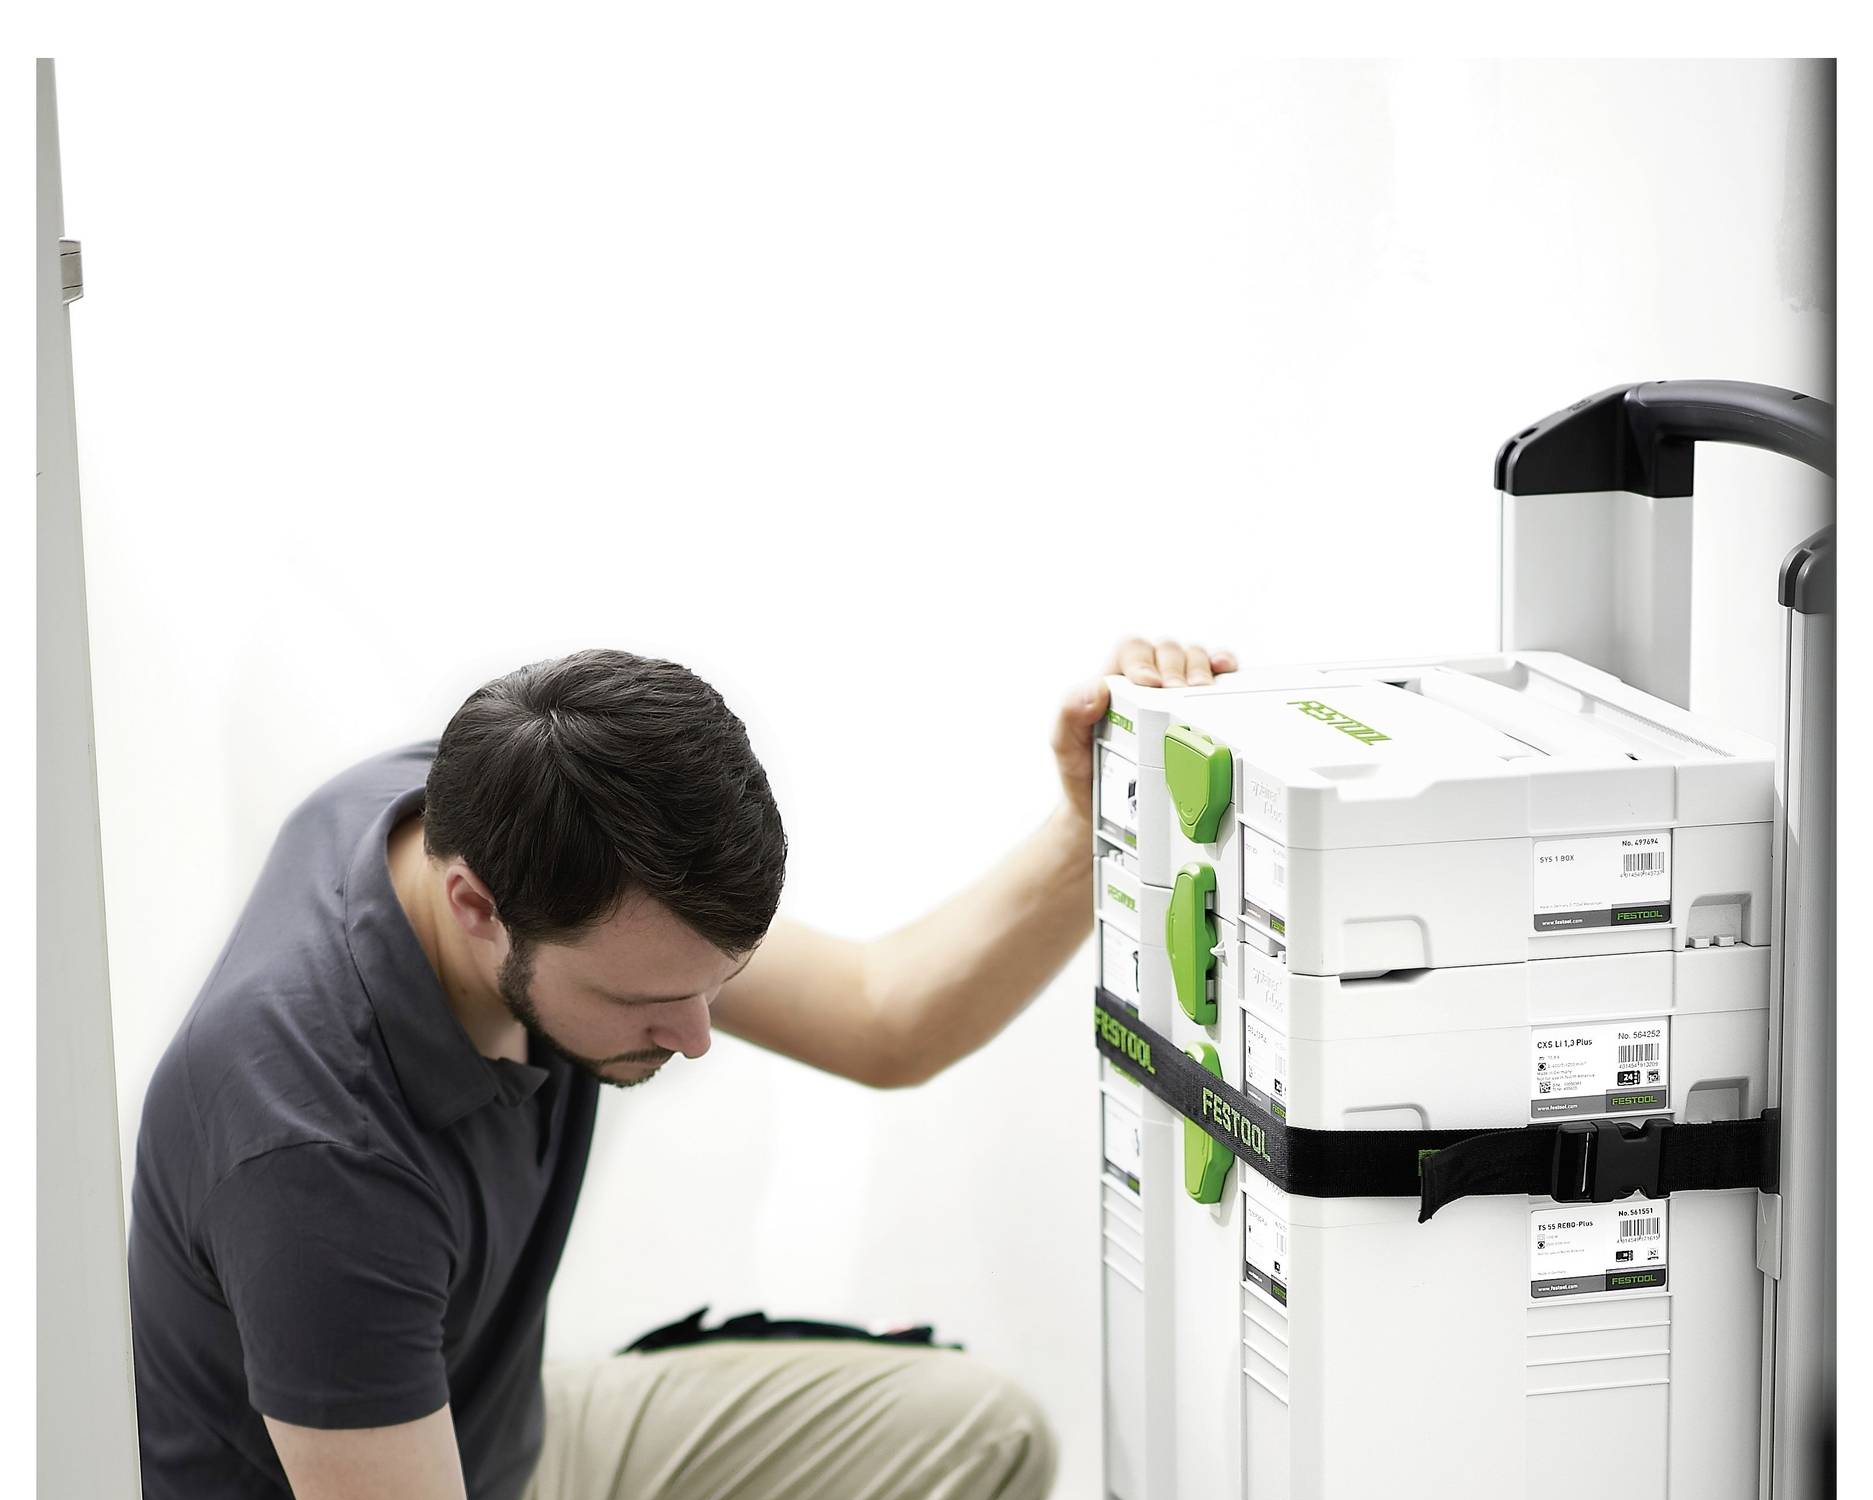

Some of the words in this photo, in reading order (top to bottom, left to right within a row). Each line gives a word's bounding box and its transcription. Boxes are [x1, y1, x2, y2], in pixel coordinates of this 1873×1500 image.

[1286, 700, 1393, 746] FESTOOL
[1634, 838, 1659, 846] 497694
[1539, 856, 1553, 864] SYS
[1555, 855, 1559, 863] 1
[1616, 910, 1664, 921] FESTOOL
[1094, 1005, 1157, 1075] FESTOOL
[1633, 1030, 1661, 1039] 564252
[1537, 1040, 1553, 1049] CXS
[1555, 1039, 1562, 1048] Li
[1564, 1039, 1575, 1048] 1,3
[1576, 1038, 1593, 1047] Plus
[1612, 1095, 1658, 1106] FESTOOL
[1202, 1086, 1271, 1163] FESTOOL
[1547, 1223, 1556, 1231] 55
[1611, 1274, 1657, 1285] FESTOOL
